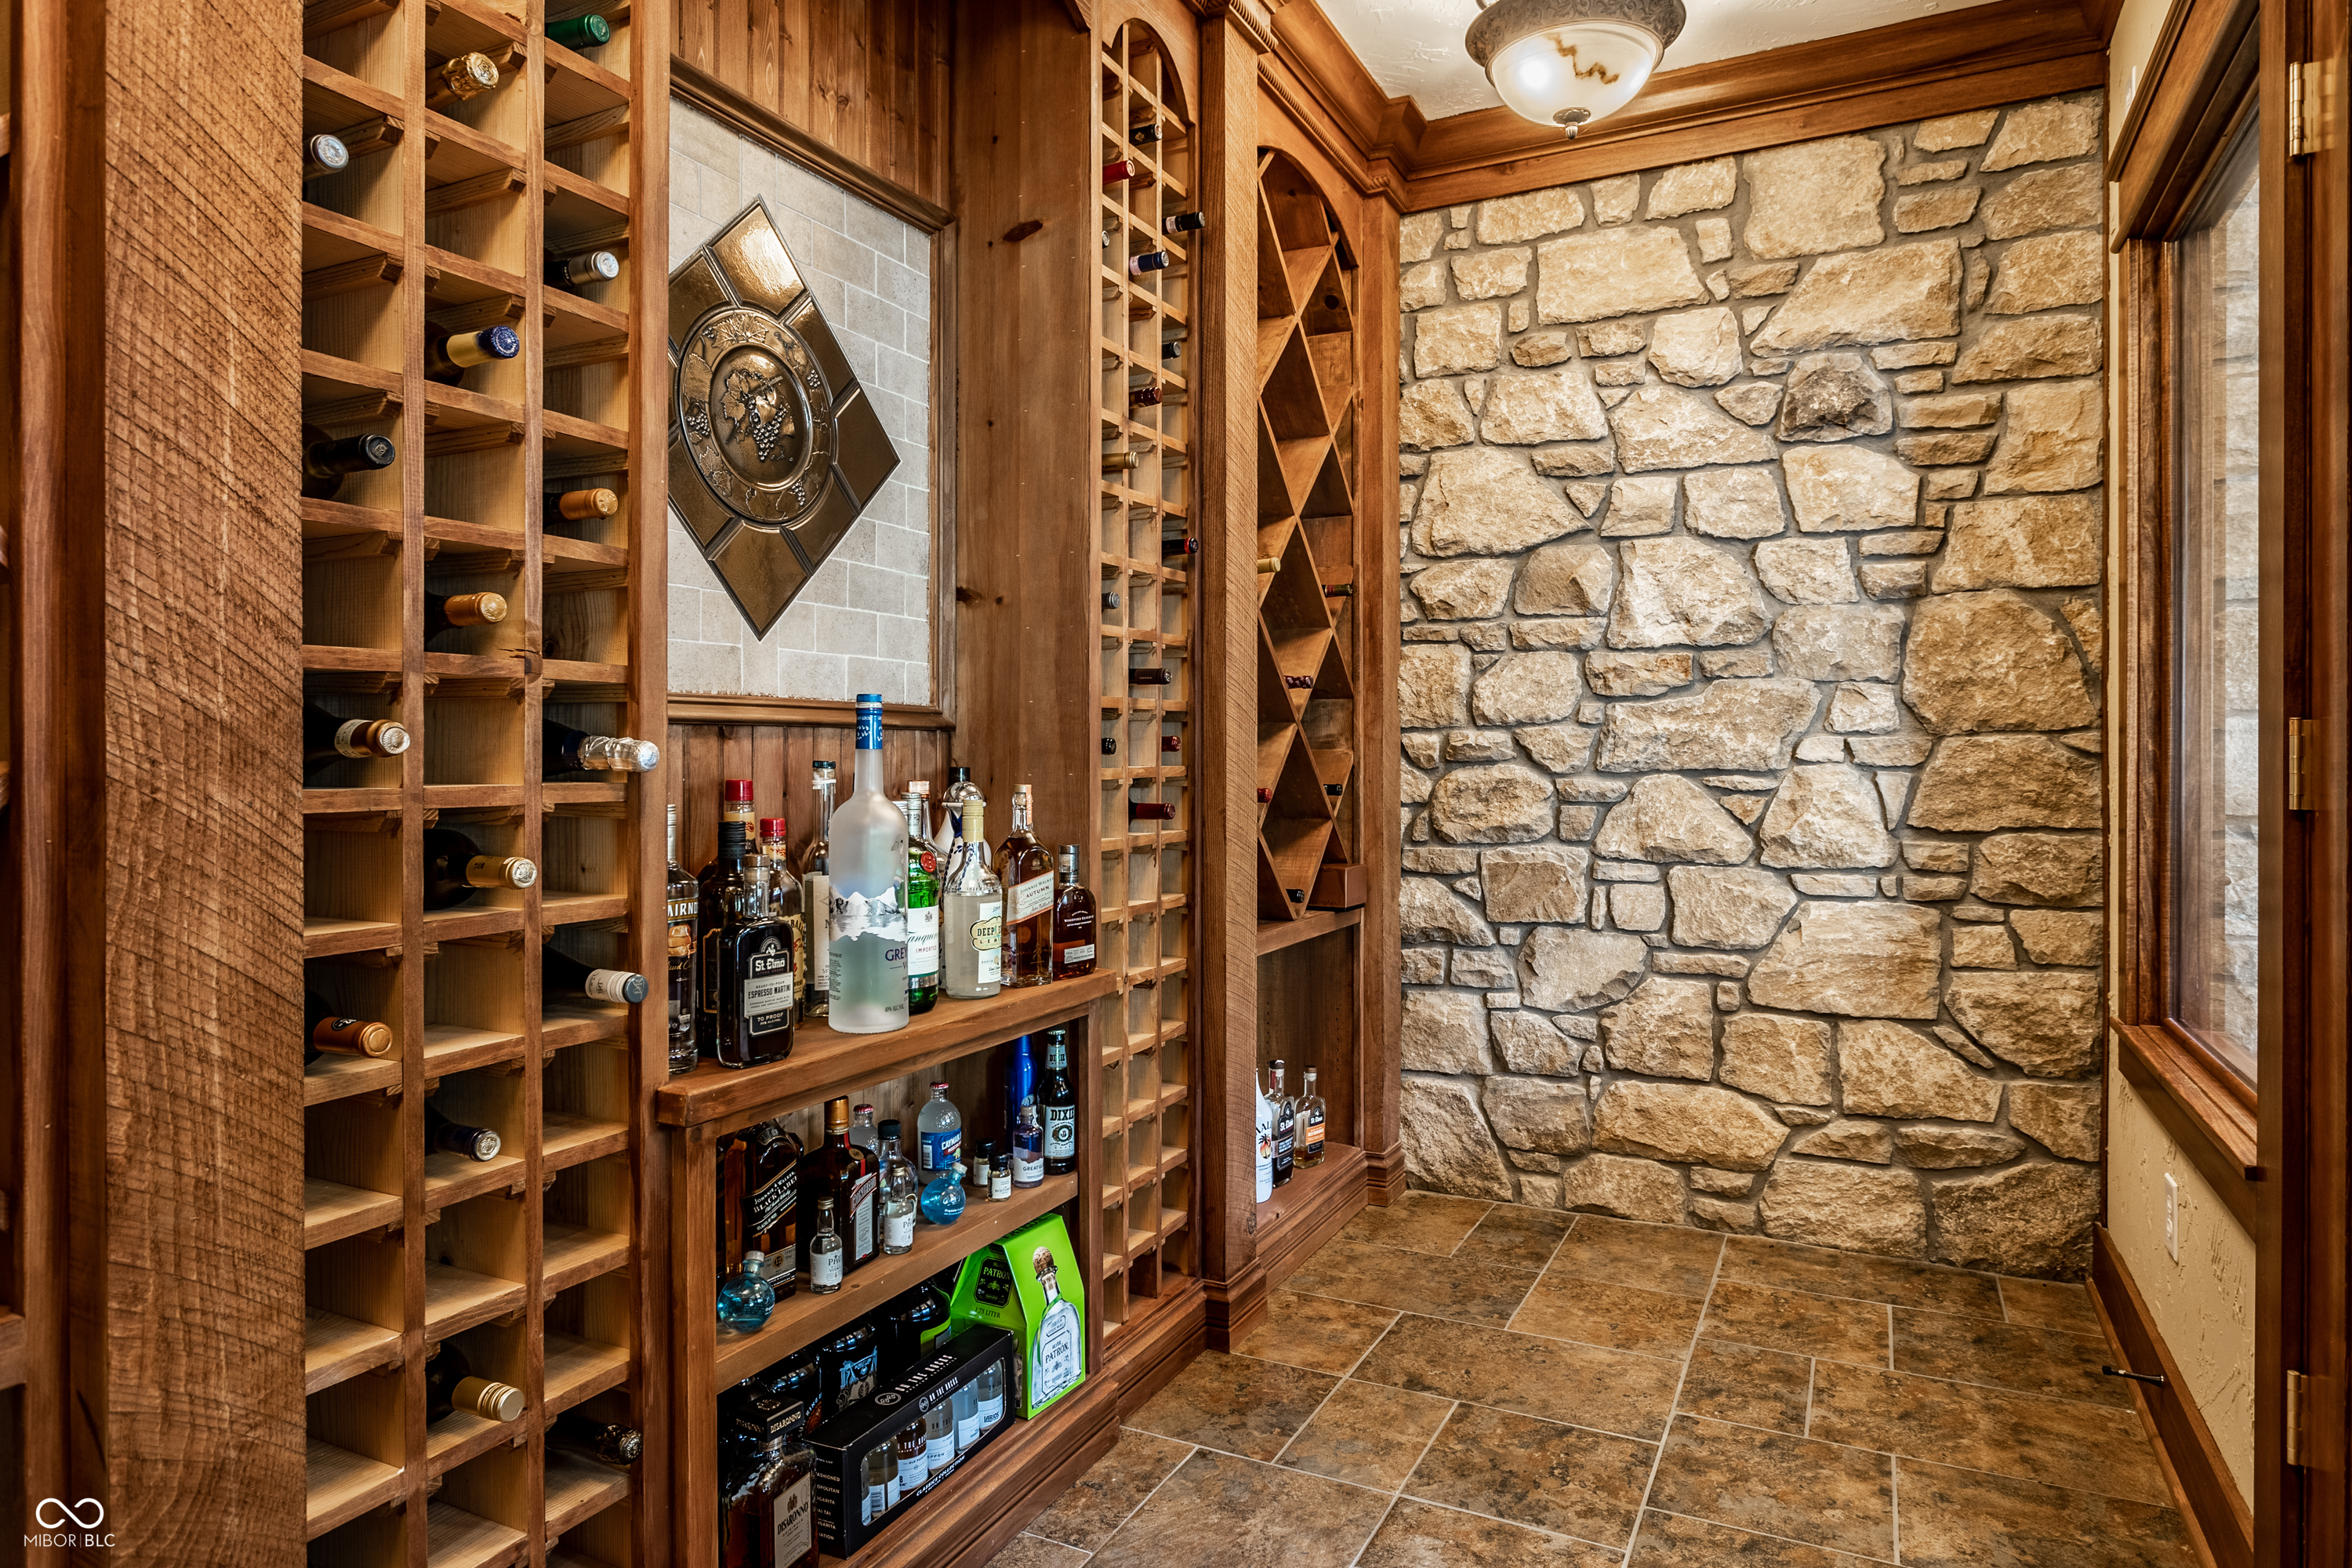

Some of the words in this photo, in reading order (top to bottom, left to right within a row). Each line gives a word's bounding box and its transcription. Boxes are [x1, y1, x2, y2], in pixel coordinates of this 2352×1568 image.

[1020, 884, 1038, 895] JOHNNIE
[1026, 885, 1050, 898] AUTUMN
[977, 927, 995, 937] DEEP
[885, 946, 907, 962] GREY
[916, 945, 937, 953] IMPORTED
[766, 958, 786, 970] Elmo
[748, 988, 772, 1000] ESPRESSO
[774, 984, 791, 994] MARTINI
[766, 1012, 784, 1021] PROOF
[1050, 1108, 1074, 1121] DIXIE
[754, 1188, 775, 1205] JOHNNIE
[851, 1176, 877, 1211] COINTREAU
[753, 1192, 777, 1213] BLACK
[983, 1266, 1011, 1280] PATRÓN
[985, 1308, 1000, 1319] LITER
[1051, 1340, 1062, 1348] SILVER
[1045, 1342, 1069, 1364] PATRÓN
[907, 1372, 927, 1383] THE
[924, 1354, 953, 1372] ROCKS
[929, 1392, 936, 1402] ON
[936, 1386, 945, 1397] THE
[945, 1377, 958, 1391] ROCKS
[770, 1411, 801, 1434] DISARONNO
[984, 1411, 1000, 1423] LARIOS
[904, 1440, 915, 1450] THE
[816, 1472, 840, 1482] ASHIONED
[916, 1476, 938, 1497] CLASSICS
[938, 1455, 965, 1479] COLLECTION
[817, 1484, 840, 1494] OPOLITAN
[777, 1501, 808, 1536] DISARONNO
[782, 1518, 804, 1537] ORIGINALE
